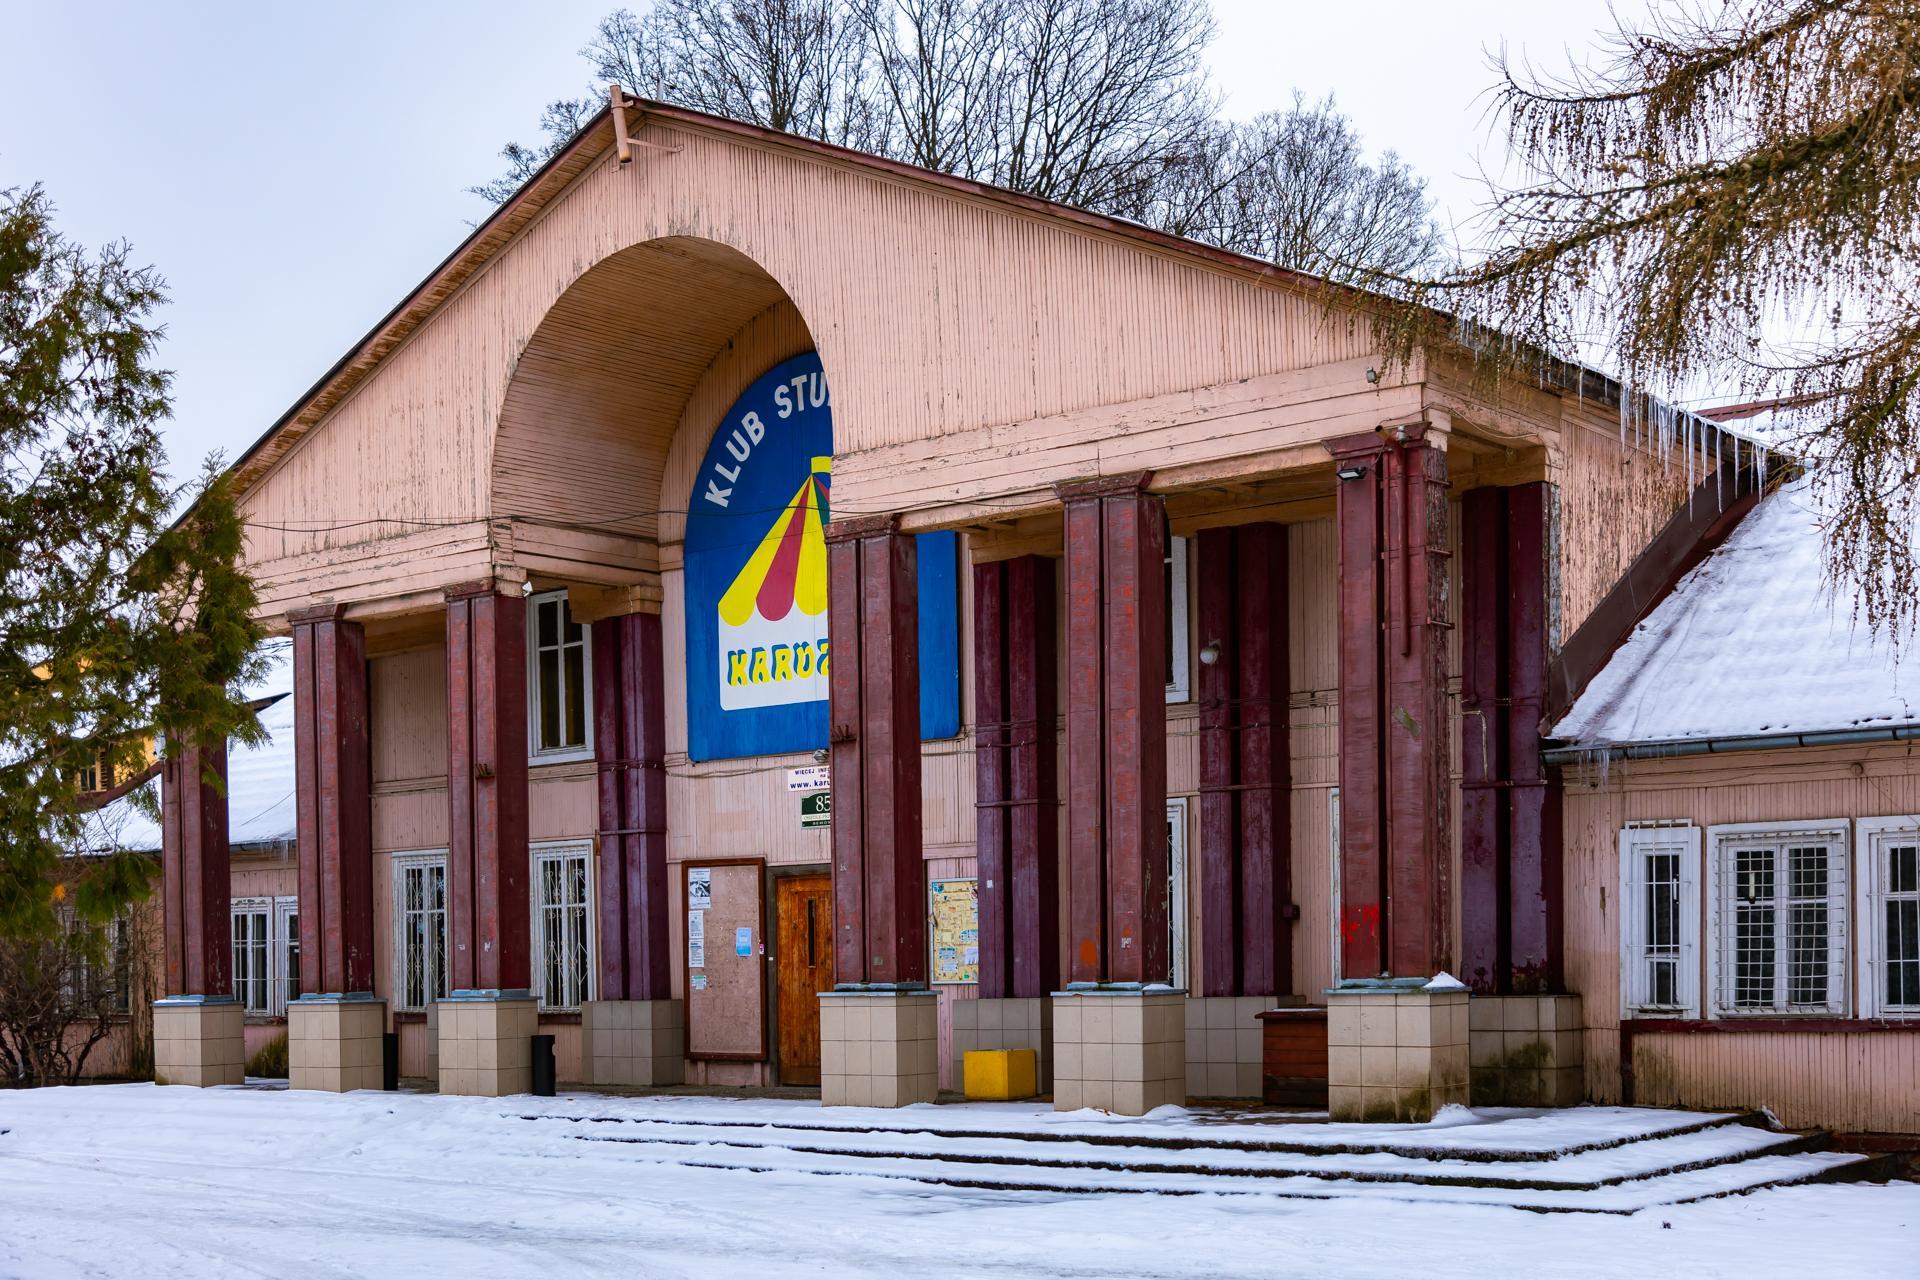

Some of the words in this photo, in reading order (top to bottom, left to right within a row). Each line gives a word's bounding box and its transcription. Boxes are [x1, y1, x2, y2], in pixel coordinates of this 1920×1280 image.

[705, 411, 765, 508] KLUB
[774, 372, 831, 418] STU
[816, 796, 830, 812] 85
